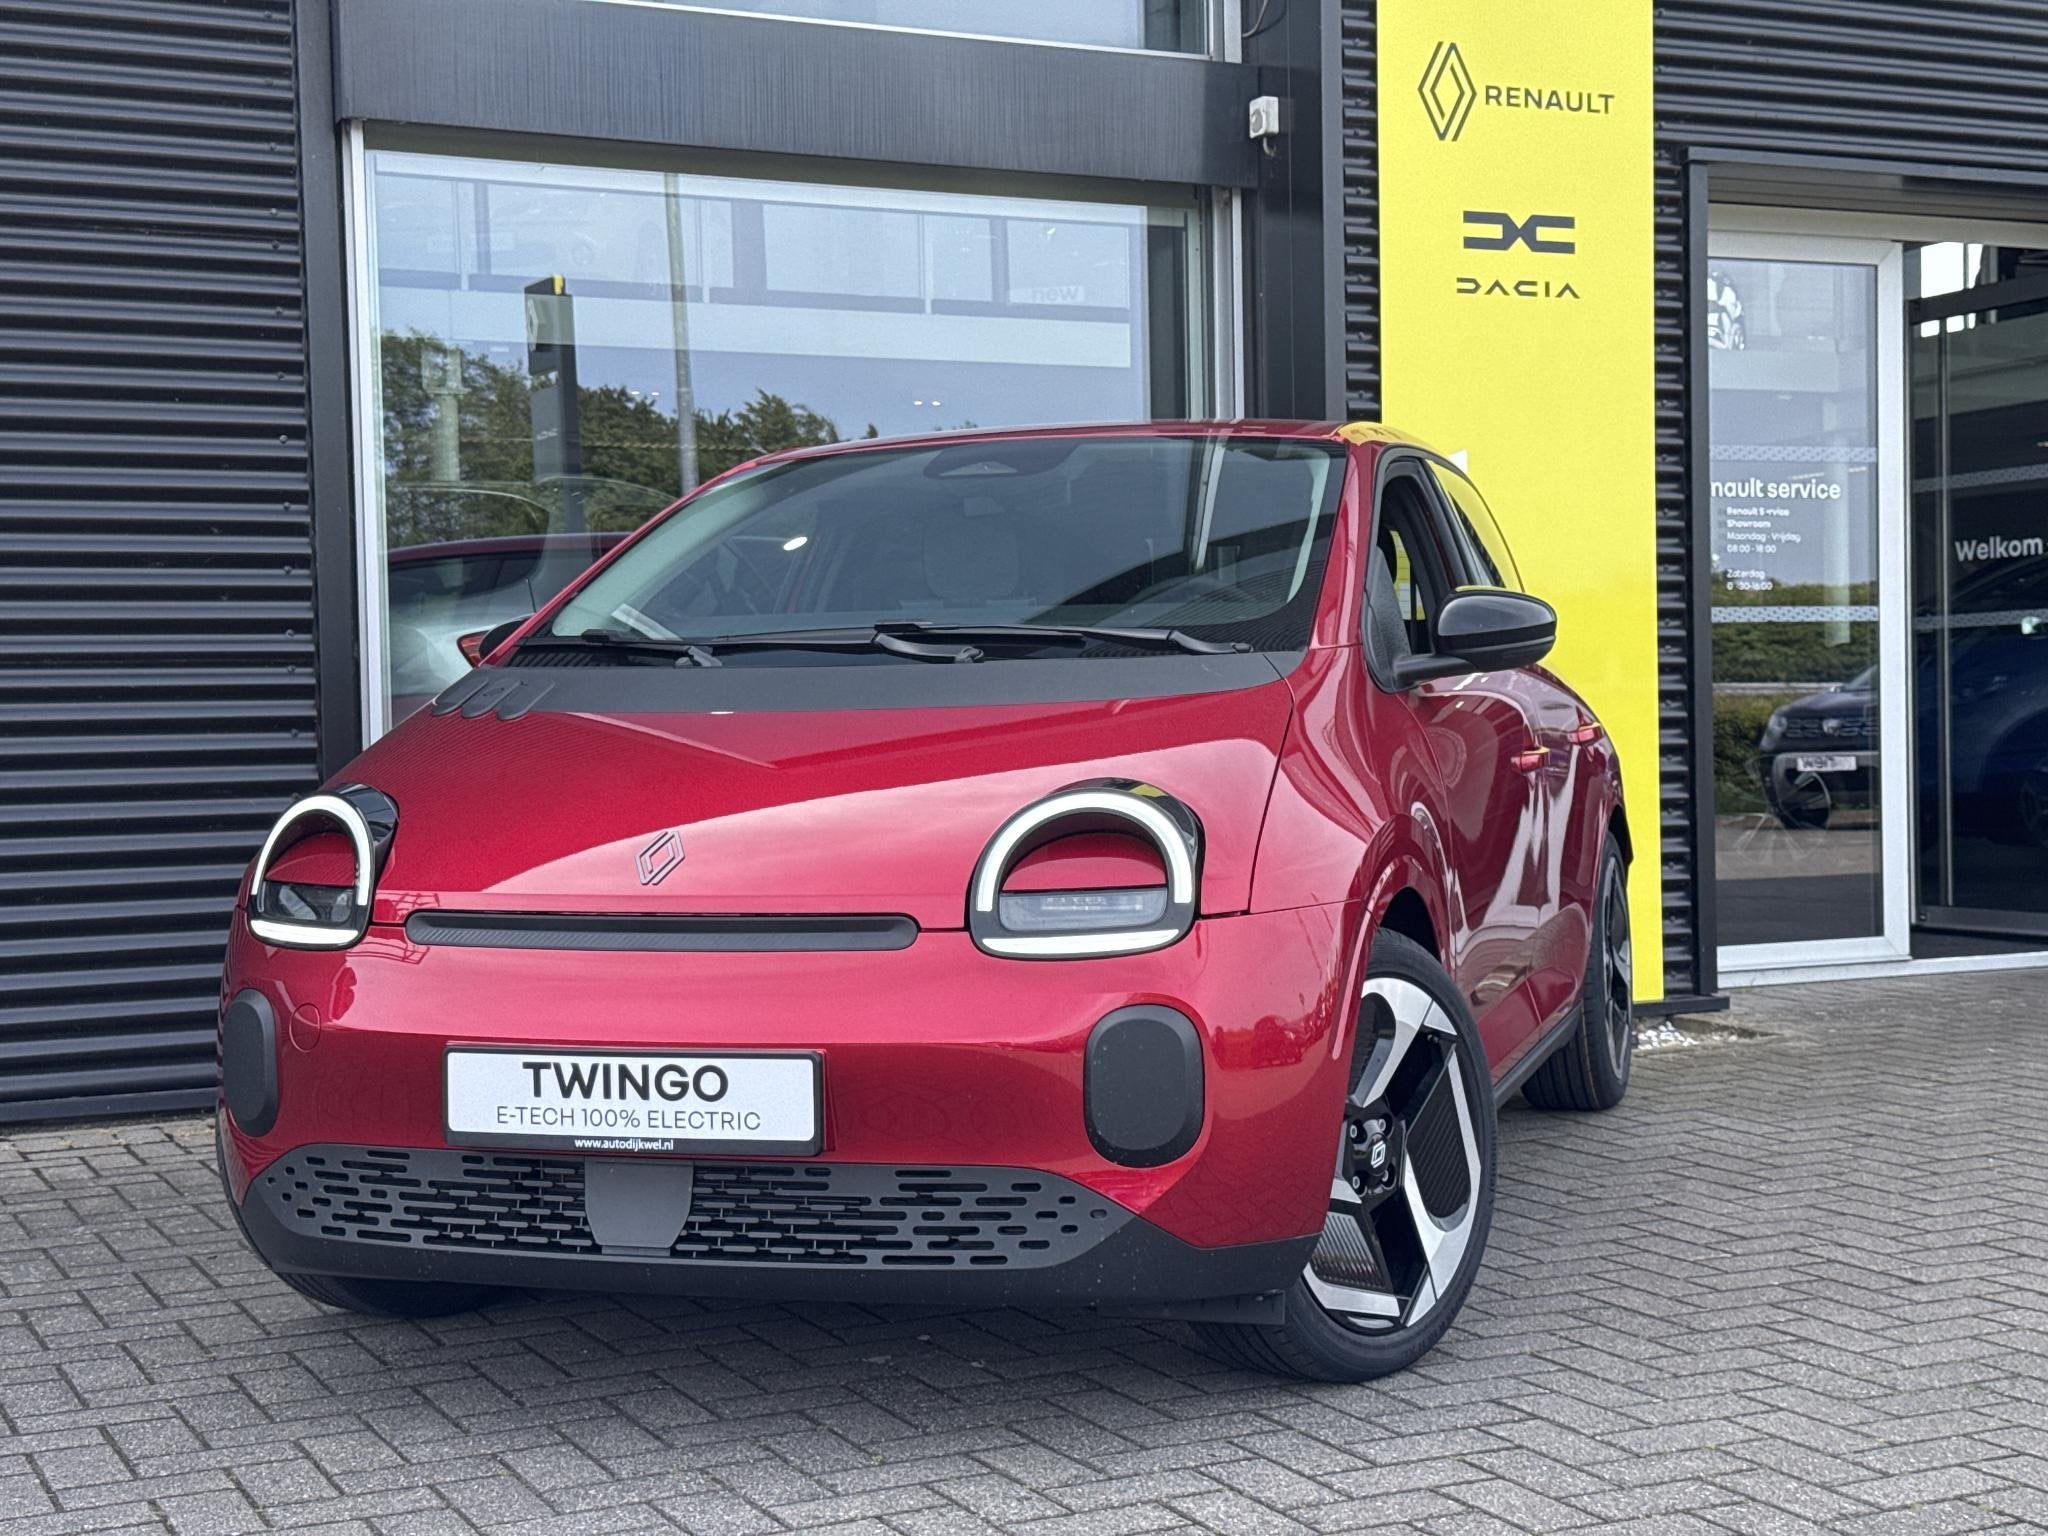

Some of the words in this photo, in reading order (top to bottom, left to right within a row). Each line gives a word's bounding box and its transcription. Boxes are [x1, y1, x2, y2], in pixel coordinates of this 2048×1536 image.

[1485, 84, 1615, 115] RENAULT
[1456, 277, 1580, 299] DACIA
[1767, 479, 1841, 499] service
[1726, 506, 1758, 516] Renault
[1726, 519, 1771, 528] Showroom
[1727, 532, 1766, 542] Maandag
[1771, 532, 1801, 543] Vrijdag
[1954, 535, 2044, 562] Welkom
[1727, 569, 1766, 579] Zaterdag
[522, 1061, 729, 1102] TWINGO
[496, 1105, 574, 1127] E-TECH
[581, 1107, 641, 1129] 100%
[648, 1110, 761, 1131] ELECTRIC
[574, 1137, 674, 1152] www.autodijkwel.nl
